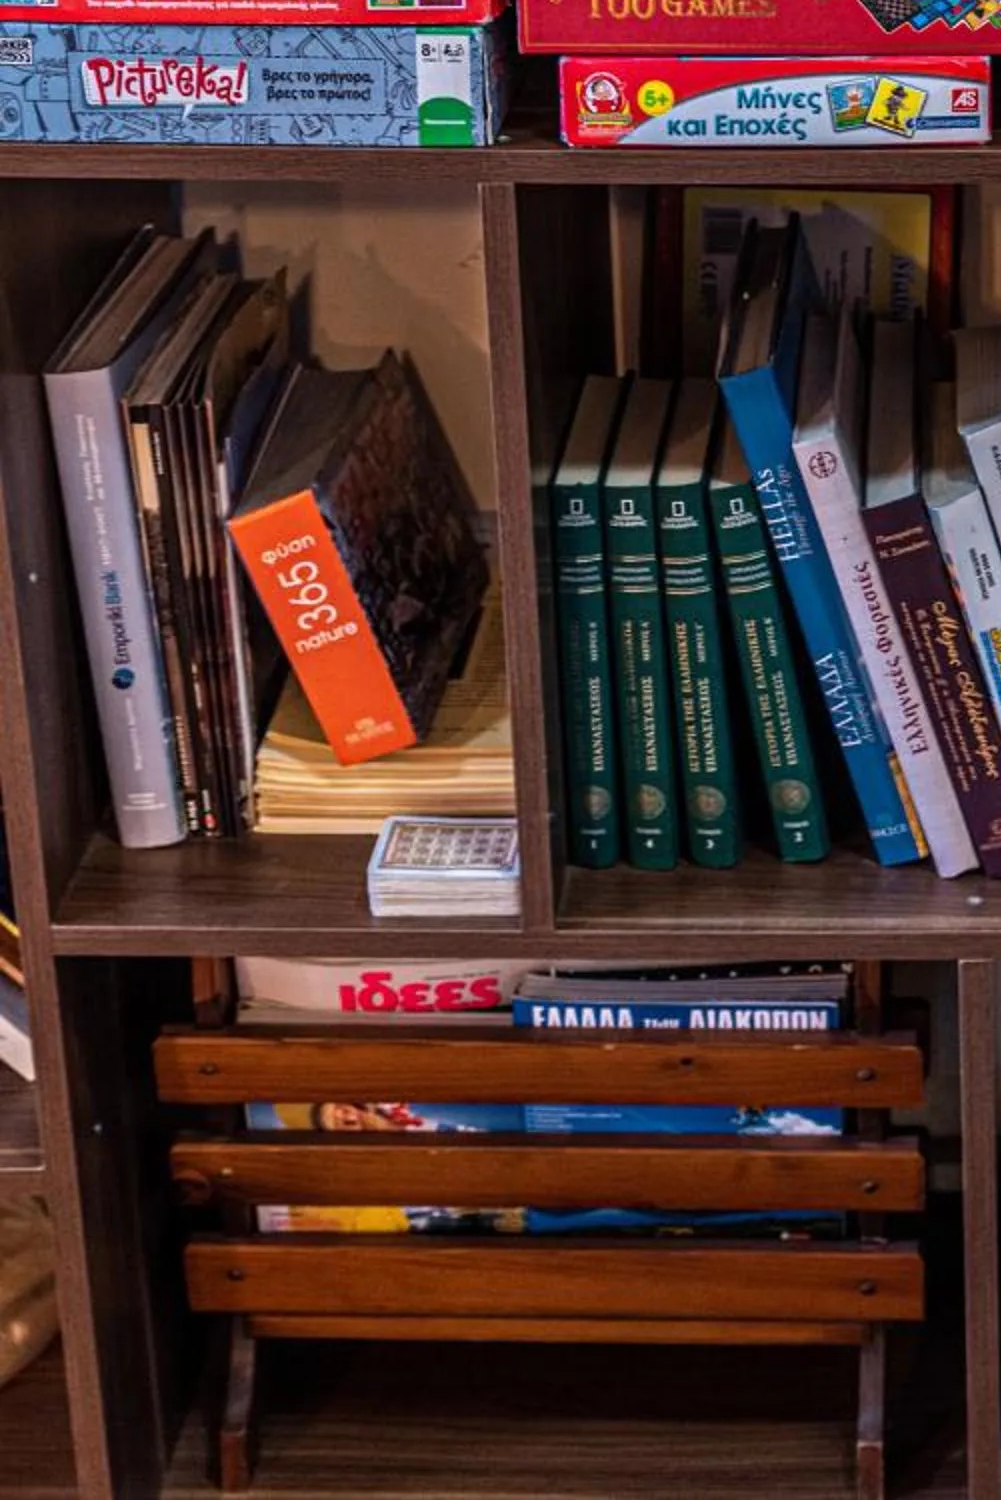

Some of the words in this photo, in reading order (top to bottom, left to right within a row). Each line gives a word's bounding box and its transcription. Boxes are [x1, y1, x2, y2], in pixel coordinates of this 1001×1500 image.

[85, 54, 248, 107] Pictureka!
[644, 89, 669, 107] 5+
[736, 86, 822, 114] Μήνες
[953, 90, 977, 108] AS
[668, 117, 706, 137] και
[715, 114, 807, 141] Εποχές
[277, 560, 338, 632] 365
[852, 560, 892, 655] Φορεσιές
[295, 621, 359, 655] nature
[815, 653, 861, 748] ΕΛΛΑΔΑ
[886, 654, 929, 756] Ελληνικές
